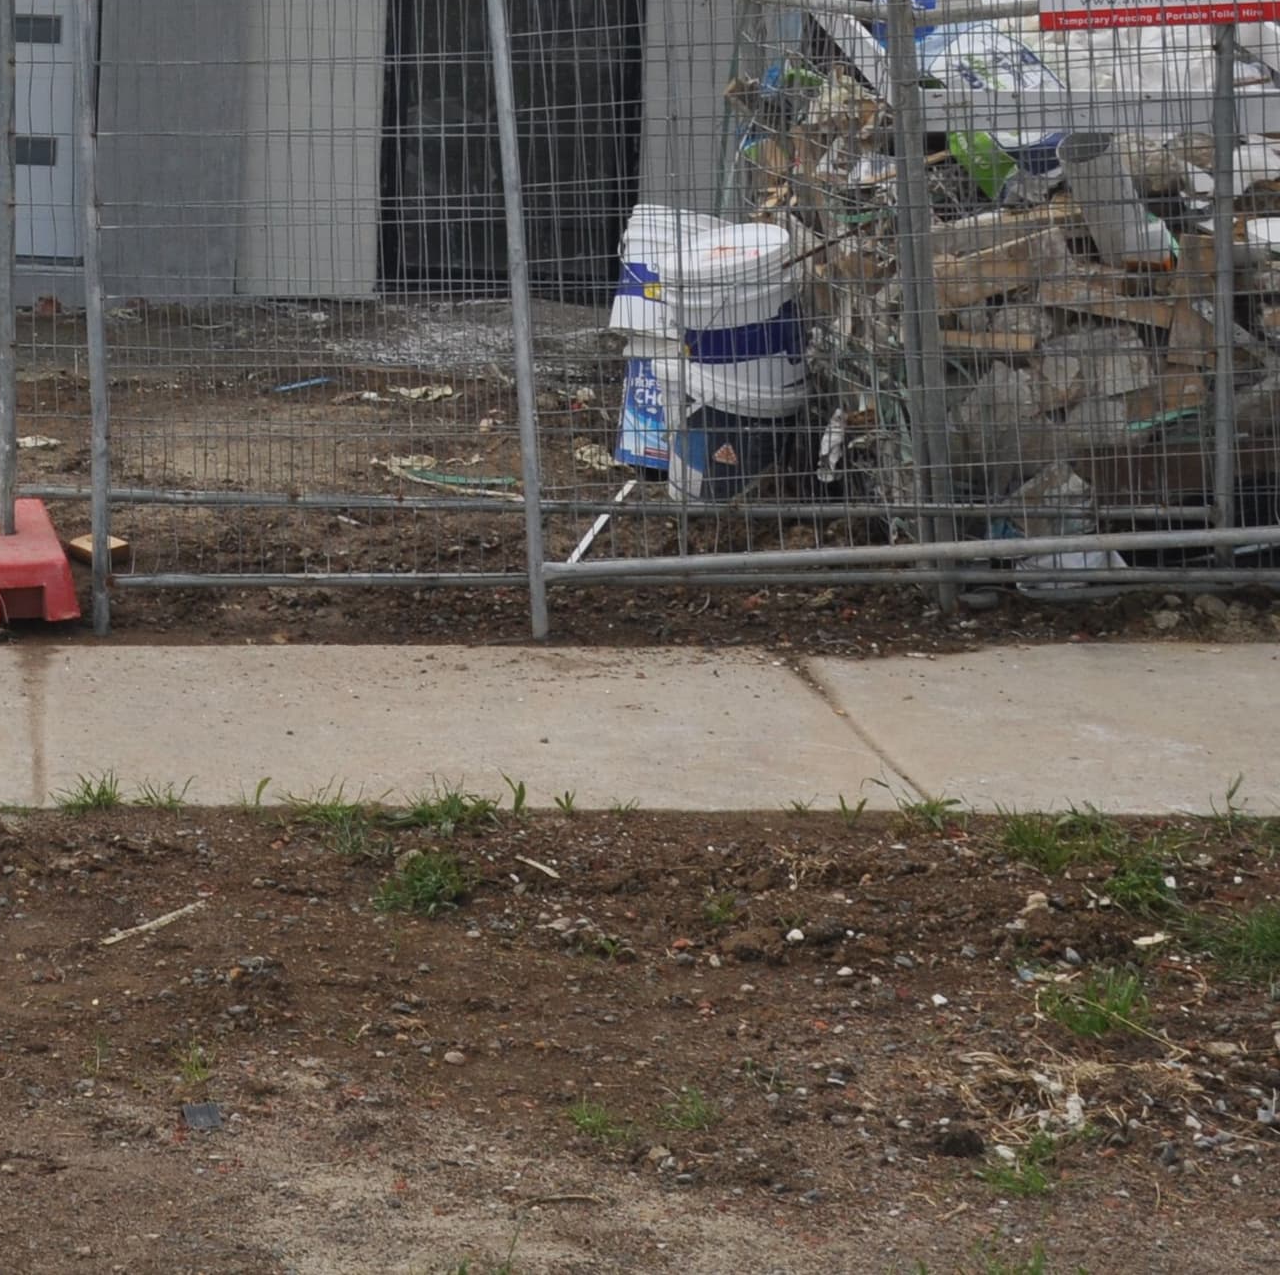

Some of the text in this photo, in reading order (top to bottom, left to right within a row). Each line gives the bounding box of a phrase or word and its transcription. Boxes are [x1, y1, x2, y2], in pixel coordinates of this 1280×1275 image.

[1058, 17, 1110, 26] Temporary
[1112, 14, 1152, 24] Fencing
[1165, 11, 1208, 21] Portable
[1210, 9, 1237, 19] Toile
[1242, 8, 1264, 17] Hire
